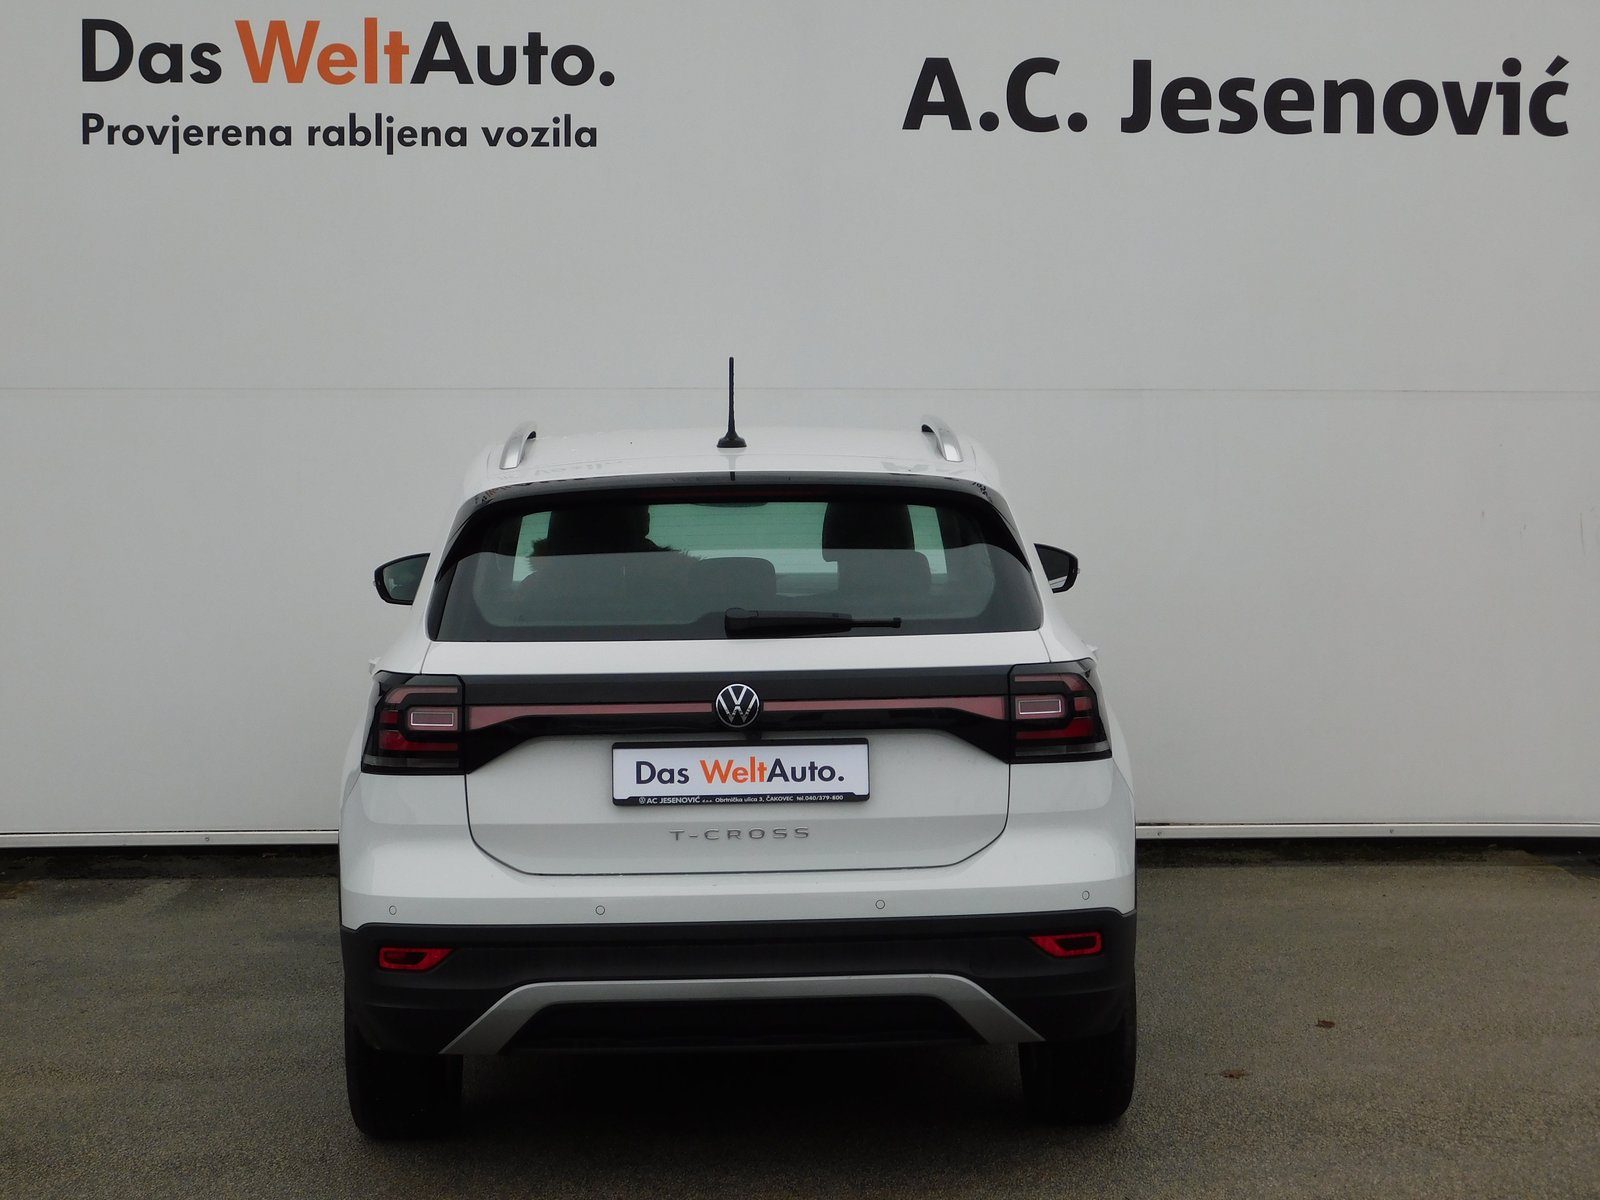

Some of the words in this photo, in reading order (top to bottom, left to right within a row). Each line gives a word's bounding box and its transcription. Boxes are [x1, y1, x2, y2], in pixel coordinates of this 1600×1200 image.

[81, 18, 222, 85] Das
[235, 16, 616, 87] WeltAuto.
[902, 56, 1088, 133] A.C.
[1121, 54, 1569, 138] Jesenović
[81, 112, 292, 155] Provjerena
[307, 112, 468, 156] rabljena
[481, 113, 597, 148] vozila
[635, 760, 690, 785] Das
[699, 755, 845, 785] WeltAuto.
[659, 795, 700, 804] JESENOVIĆ
[766, 794, 794, 802] ČAKOVEC
[670, 826, 809, 841] T-CROSS
